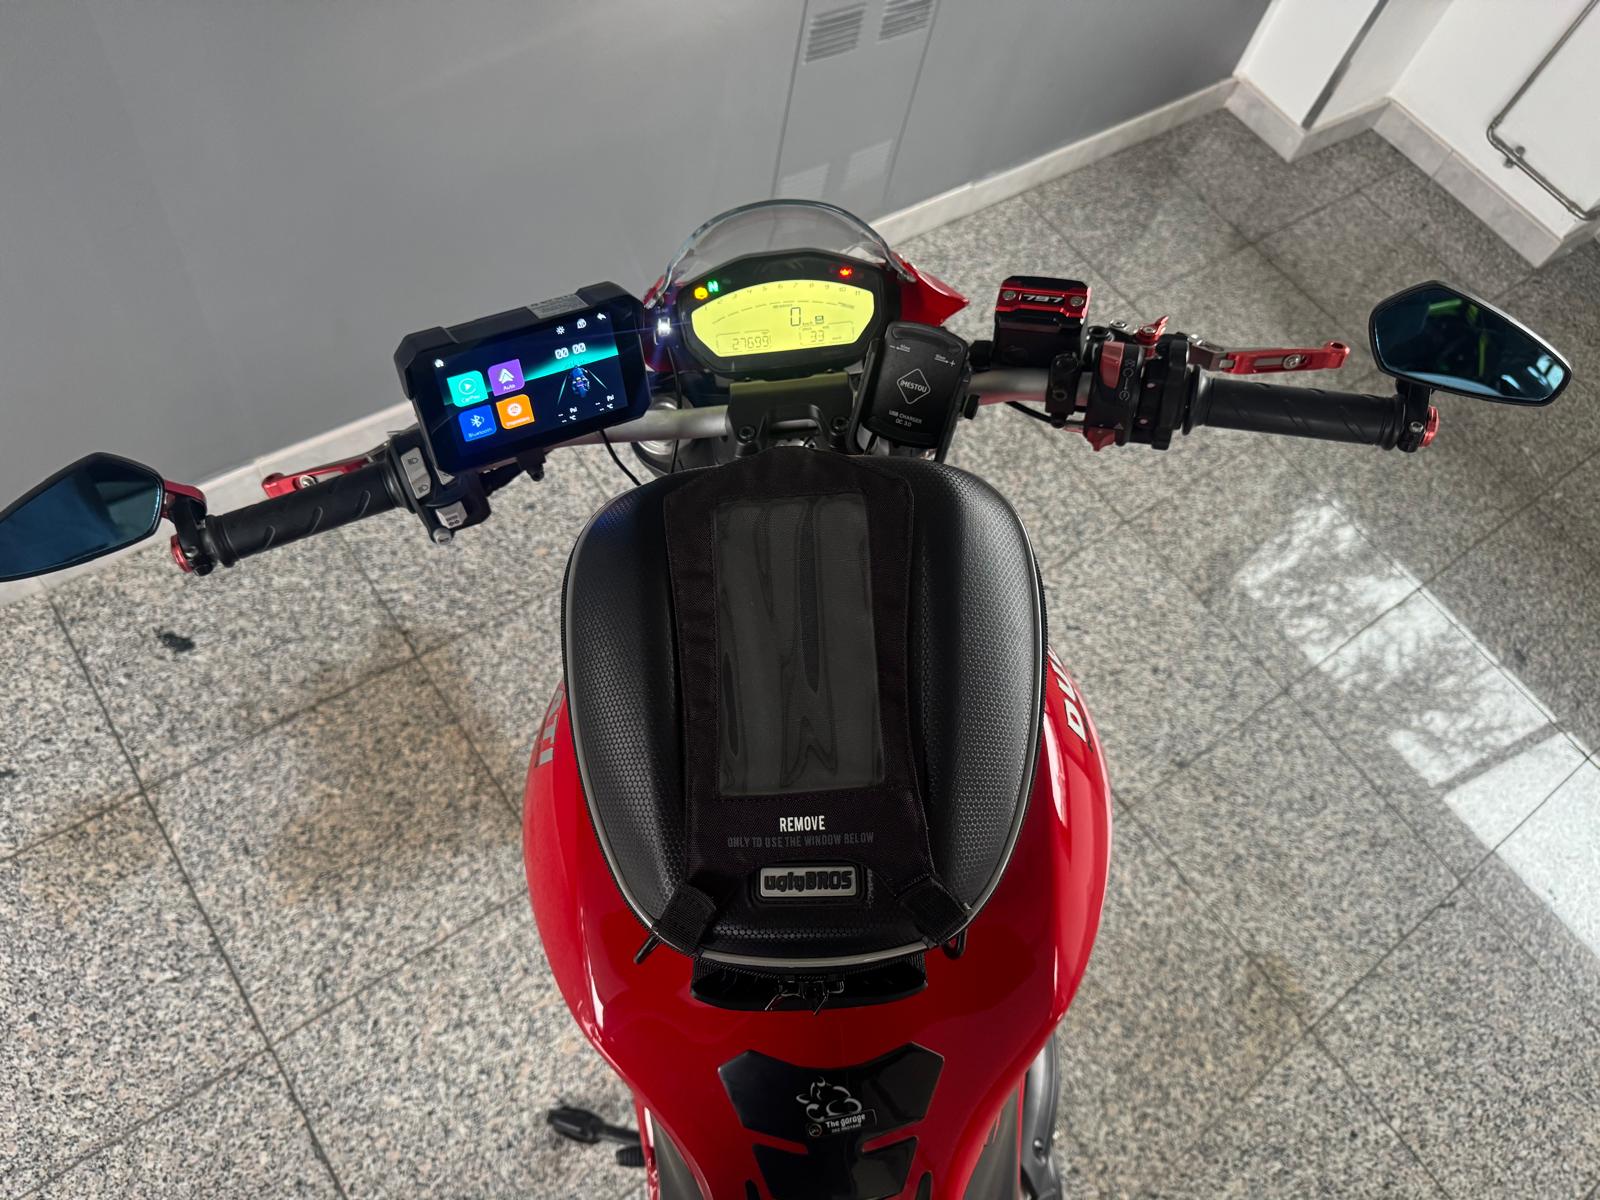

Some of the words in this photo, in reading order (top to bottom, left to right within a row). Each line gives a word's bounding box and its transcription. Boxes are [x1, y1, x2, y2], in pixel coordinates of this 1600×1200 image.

[707, 280, 719, 292] N
[790, 306, 801, 327] 0
[732, 335, 769, 351] 27699
[811, 329, 824, 342] 33
[779, 815, 826, 832] REMOVE
[727, 836, 750, 848] ONLY
[752, 837, 762, 848] TO
[765, 836, 784, 848] USE
[785, 836, 801, 848] THE
[804, 833, 841, 846] WINDOW
[844, 832, 874, 844] BELOW
[764, 870, 853, 893] uglyBROS
[825, 1120, 840, 1128] The
[840, 1114, 866, 1128] garage
